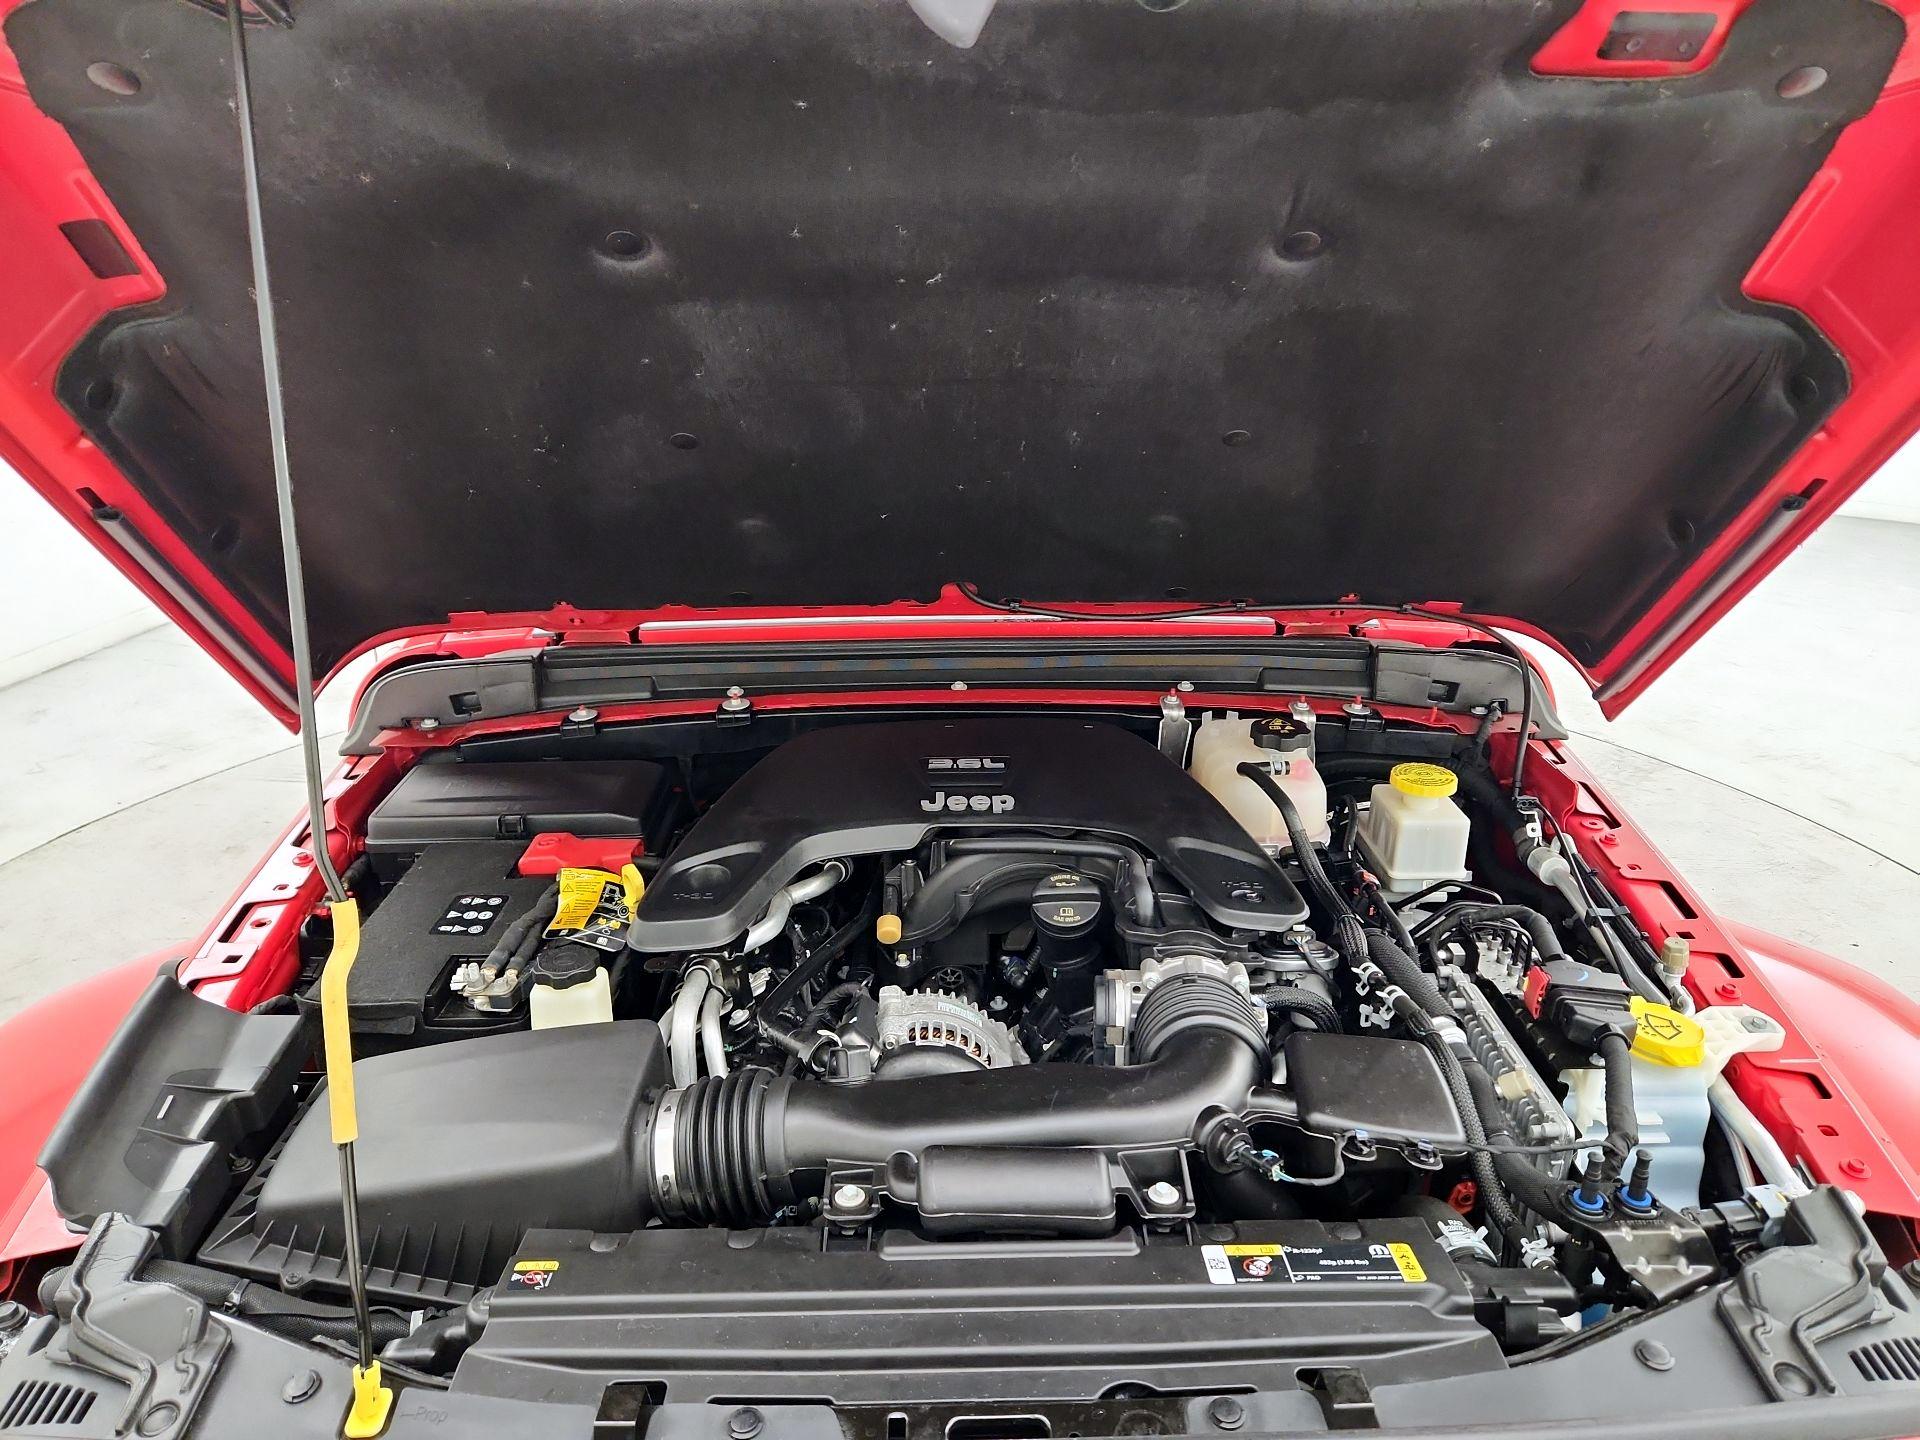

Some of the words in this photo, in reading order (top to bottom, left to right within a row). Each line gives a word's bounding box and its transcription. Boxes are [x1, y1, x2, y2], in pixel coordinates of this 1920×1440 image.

[928, 758, 1005, 769] 3.6L
[920, 791, 1015, 814] Jeep
[415, 1406, 449, 1425] Prop
